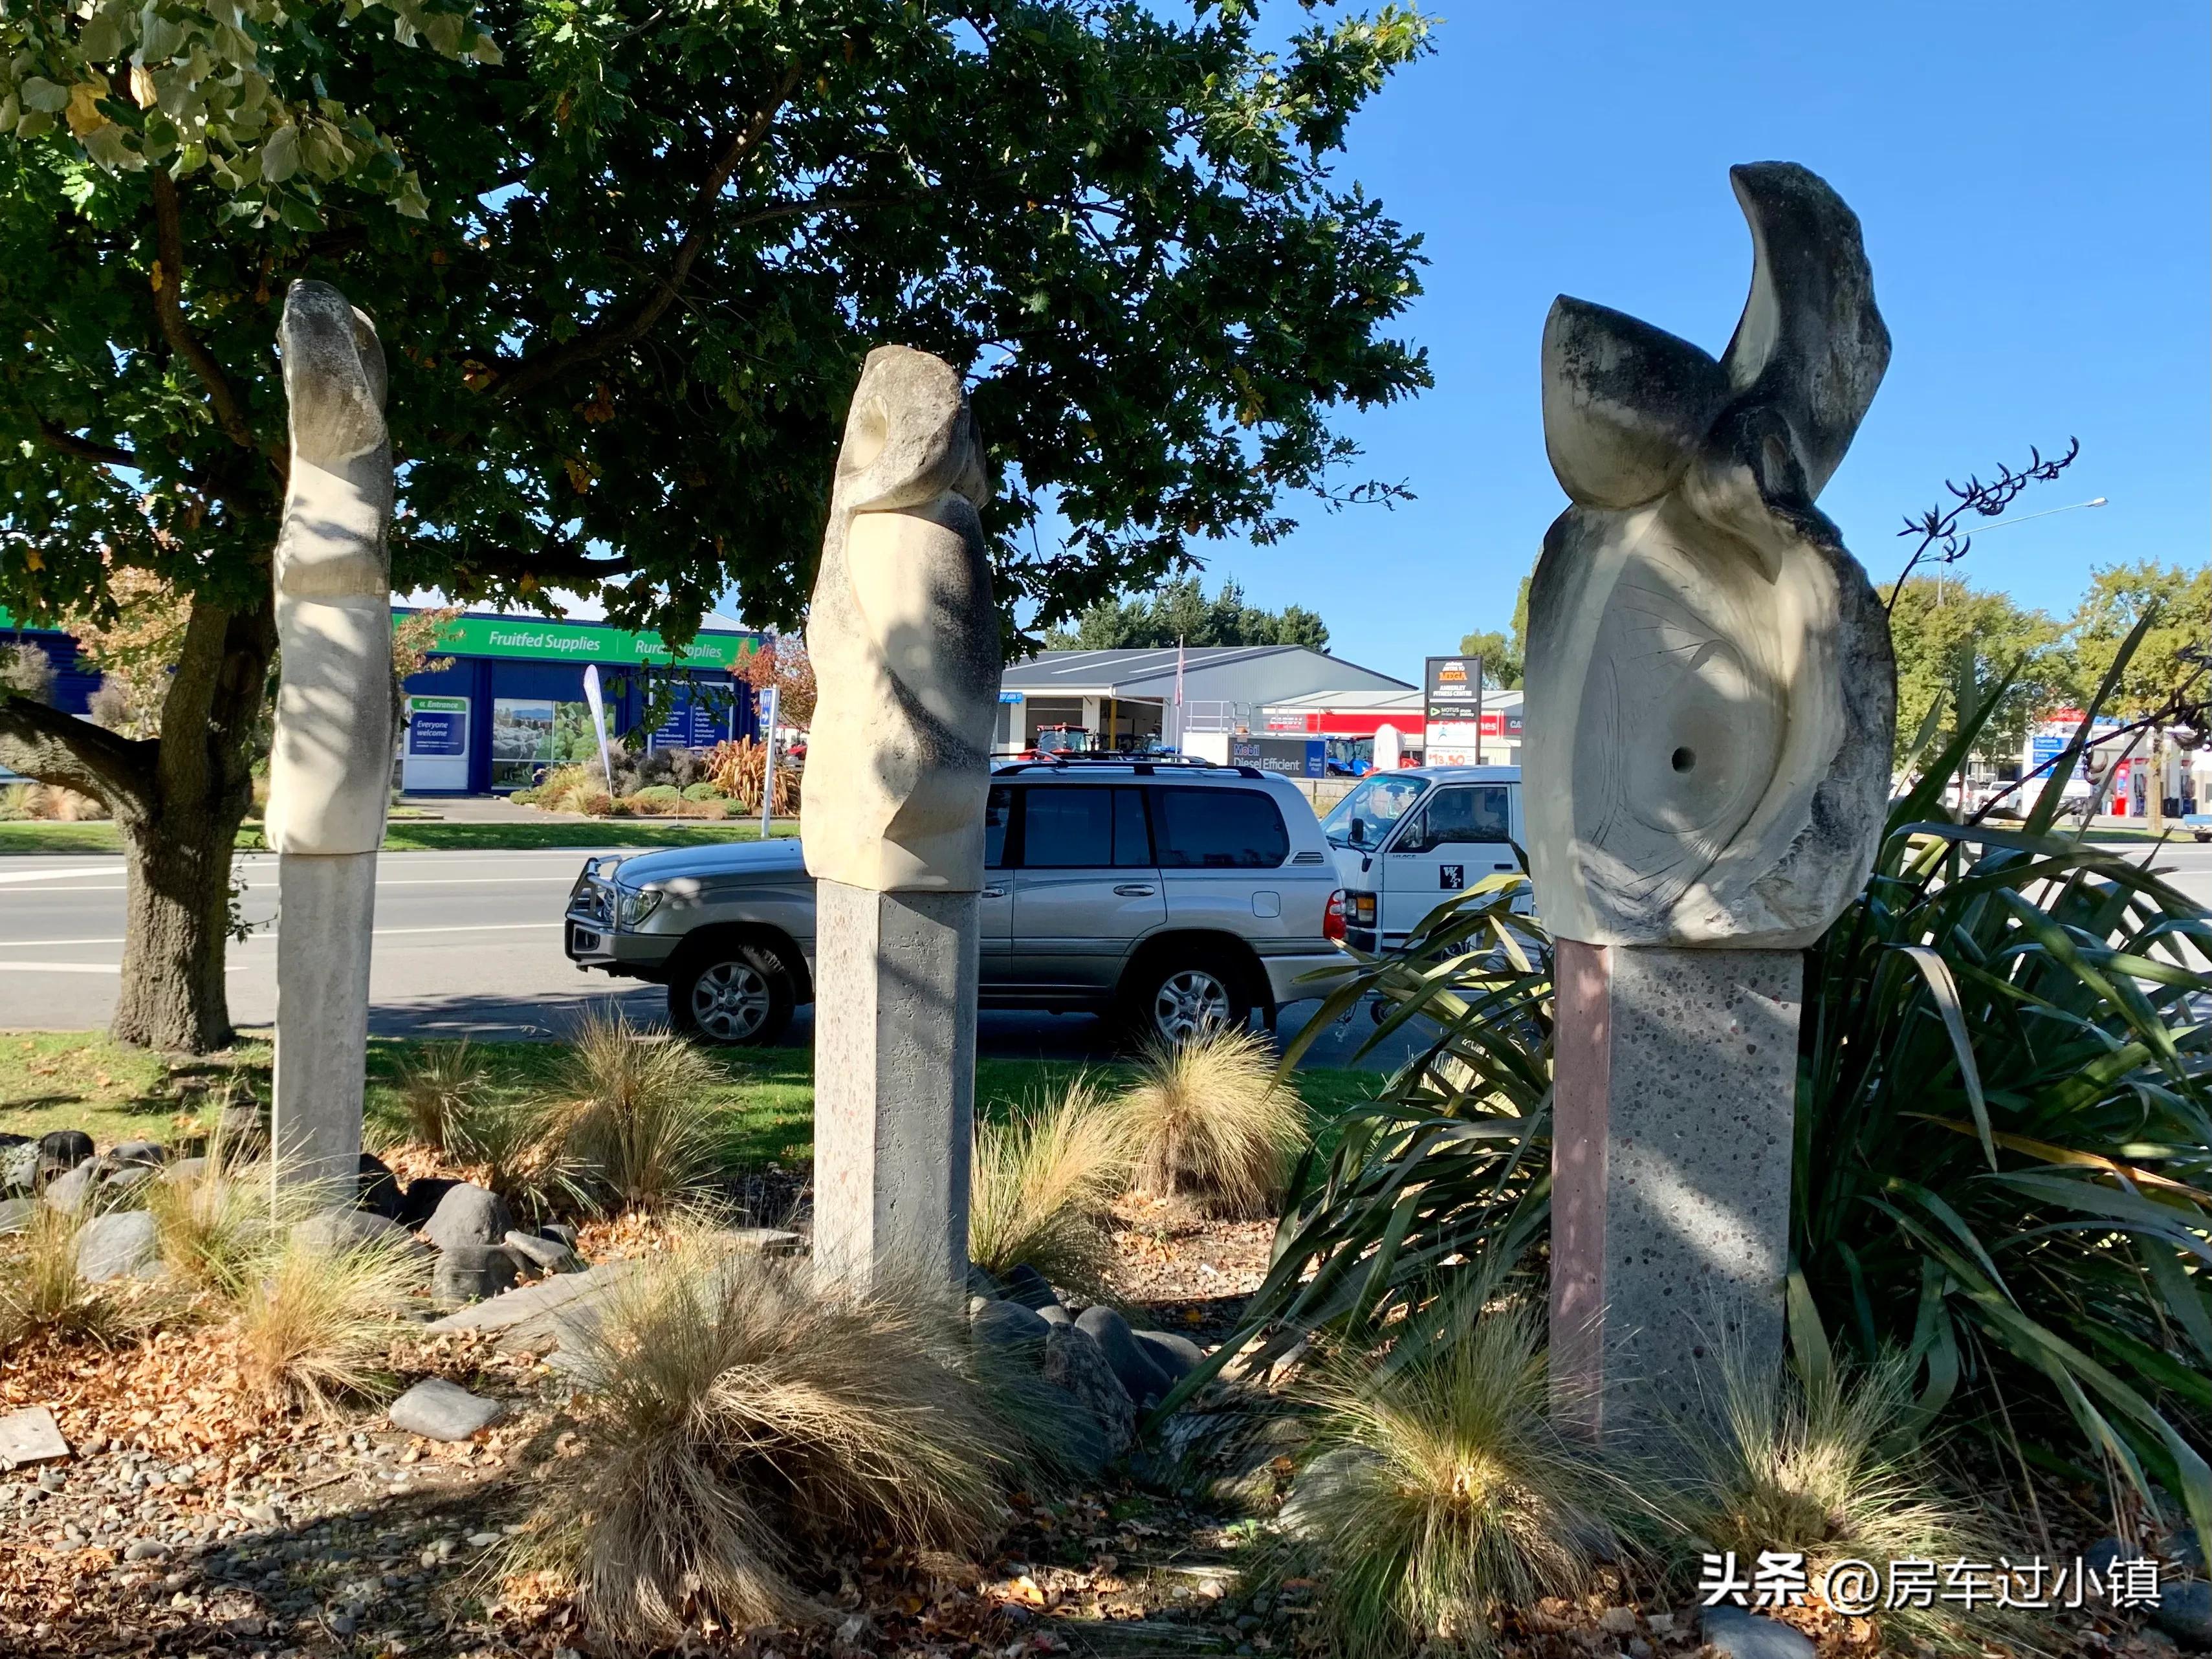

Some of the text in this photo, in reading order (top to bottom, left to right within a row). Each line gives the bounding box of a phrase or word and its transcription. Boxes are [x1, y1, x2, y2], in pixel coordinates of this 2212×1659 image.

[488, 631, 600, 652] Fruitfed Supplies
[635, 639, 722, 659] Rura upplies
[1439, 672, 1468, 681] MEGA
[417, 720, 448, 729] Everyone
[1510, 720, 1522, 729] CA
[1234, 744, 1260, 756] Mobil
[1234, 757, 1301, 771] Diesel Efficient
